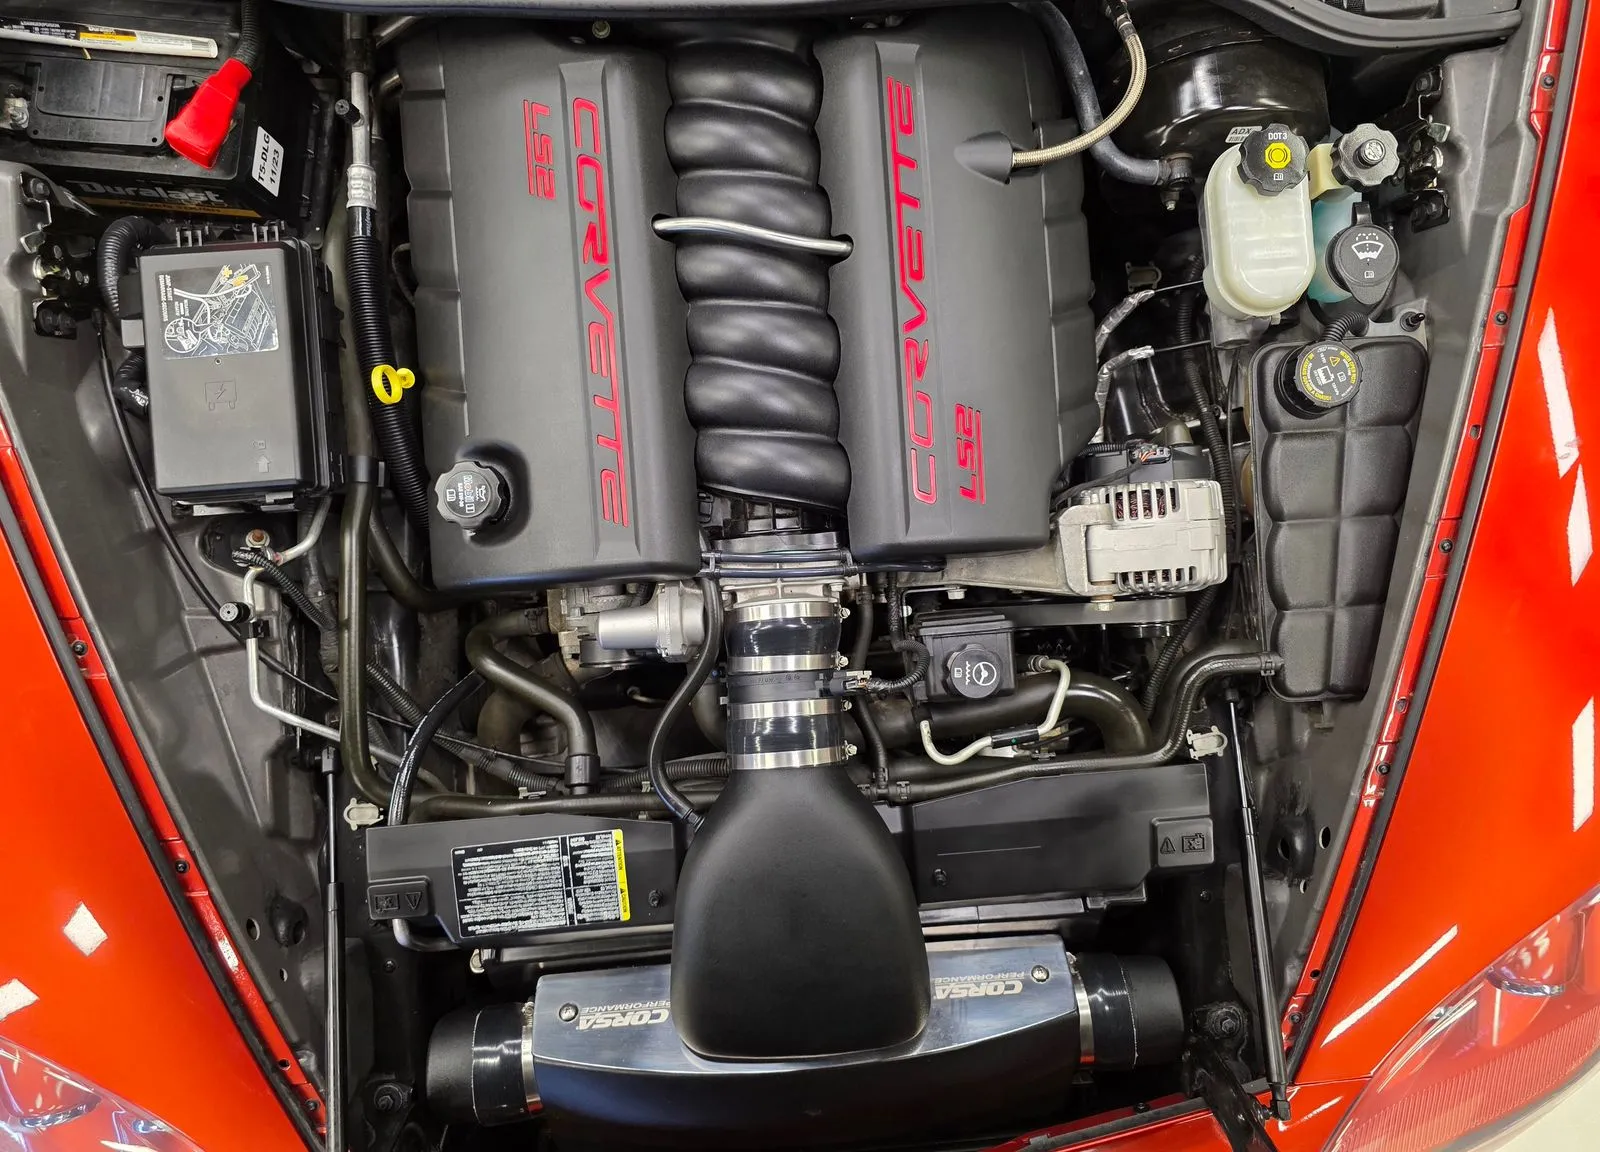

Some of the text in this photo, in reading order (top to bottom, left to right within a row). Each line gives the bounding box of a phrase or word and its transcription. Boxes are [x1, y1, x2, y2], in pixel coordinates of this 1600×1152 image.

[258, 133, 270, 182] T5-DLG
[270, 148, 280, 185] 11/23
[530, 101, 556, 201] LS2
[70, 179, 223, 203] Duralast
[886, 76, 937, 505] CORVETTE
[573, 97, 628, 527] CORVETTE
[955, 402, 977, 502] LS2
[464, 475, 473, 502] Mobil
[935, 980, 1023, 1000] CORSA
[936, 970, 1025, 984] PERFORMANCE
[578, 1008, 670, 1030] CORSA
